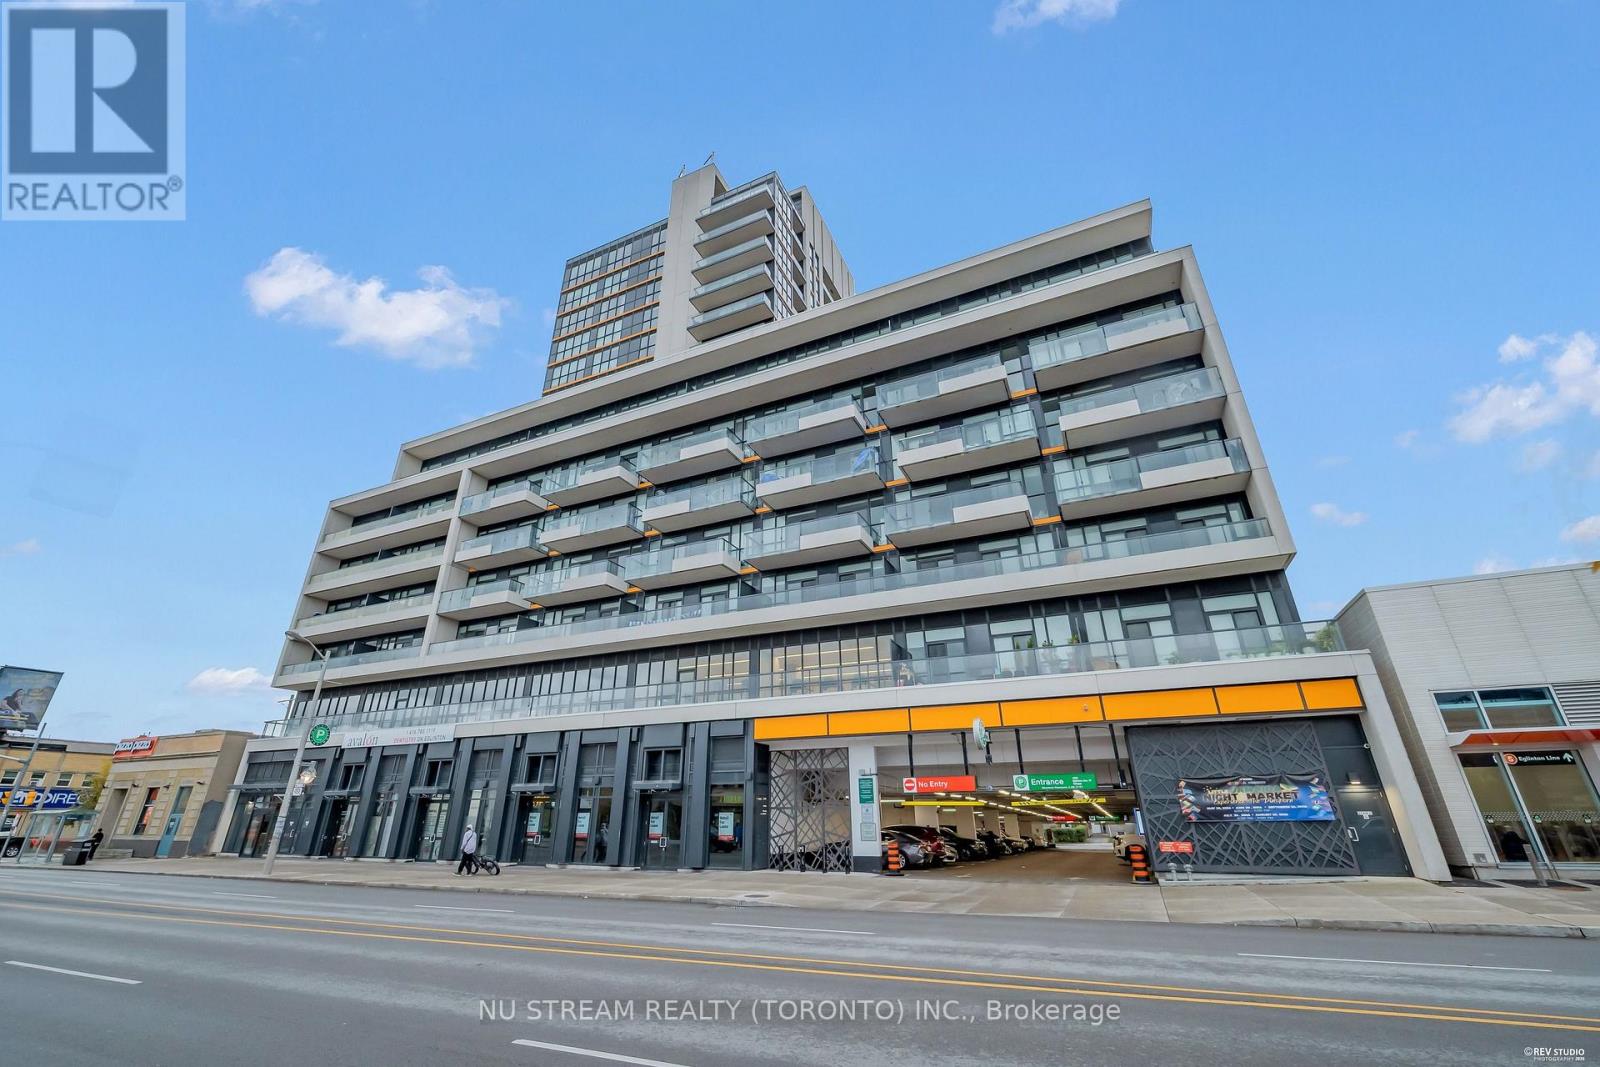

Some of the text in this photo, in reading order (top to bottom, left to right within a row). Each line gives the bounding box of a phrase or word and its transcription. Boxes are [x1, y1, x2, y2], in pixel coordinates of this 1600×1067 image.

[347, 733, 379, 747] avalon
[929, 780, 949, 790] Entry
[1030, 778, 1064, 786] Entrance
[1246, 792, 1299, 800] MARKET
